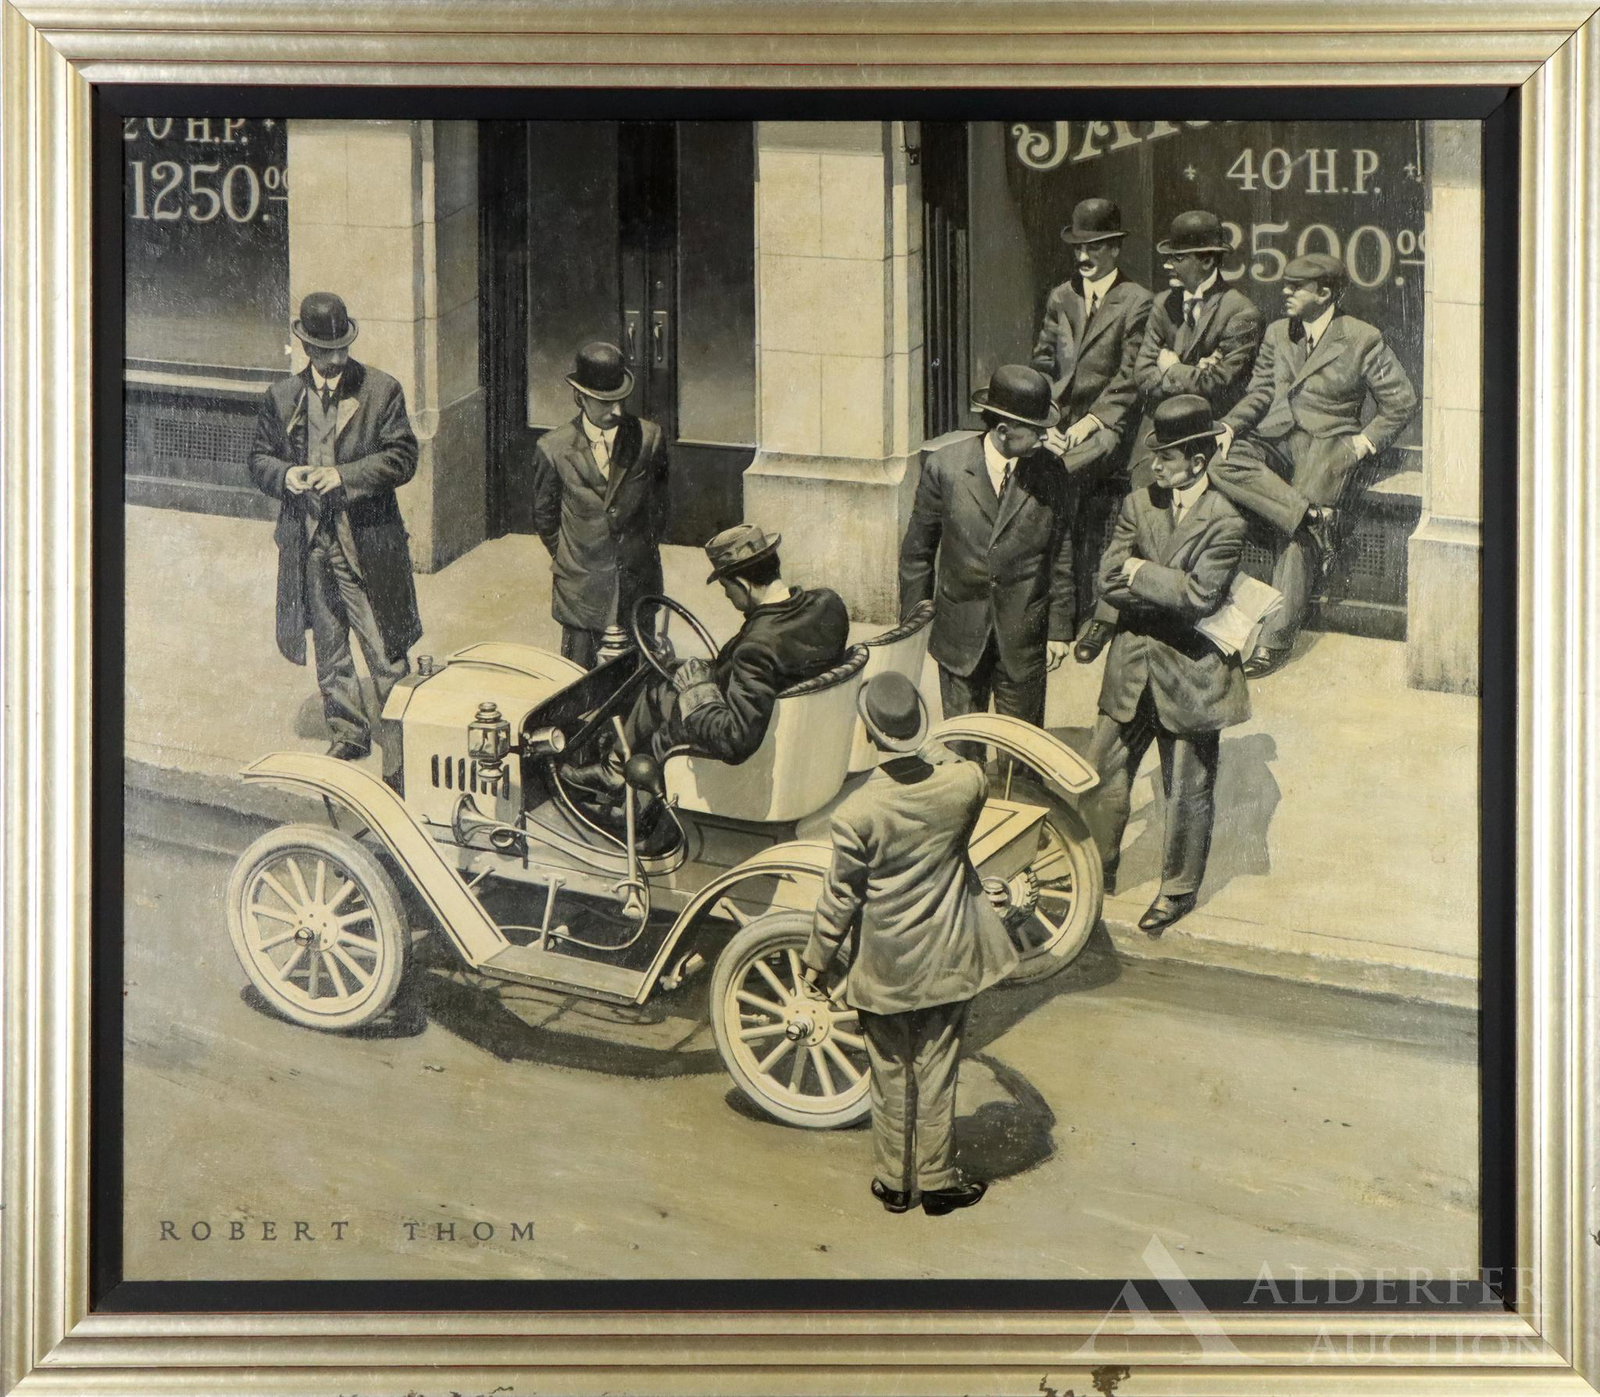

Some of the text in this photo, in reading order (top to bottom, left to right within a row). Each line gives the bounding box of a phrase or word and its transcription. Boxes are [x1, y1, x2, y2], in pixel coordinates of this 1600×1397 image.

[1226, 148, 1381, 194] 40 H.P.
[159, 1220, 536, 1242] ROBERT THOM
